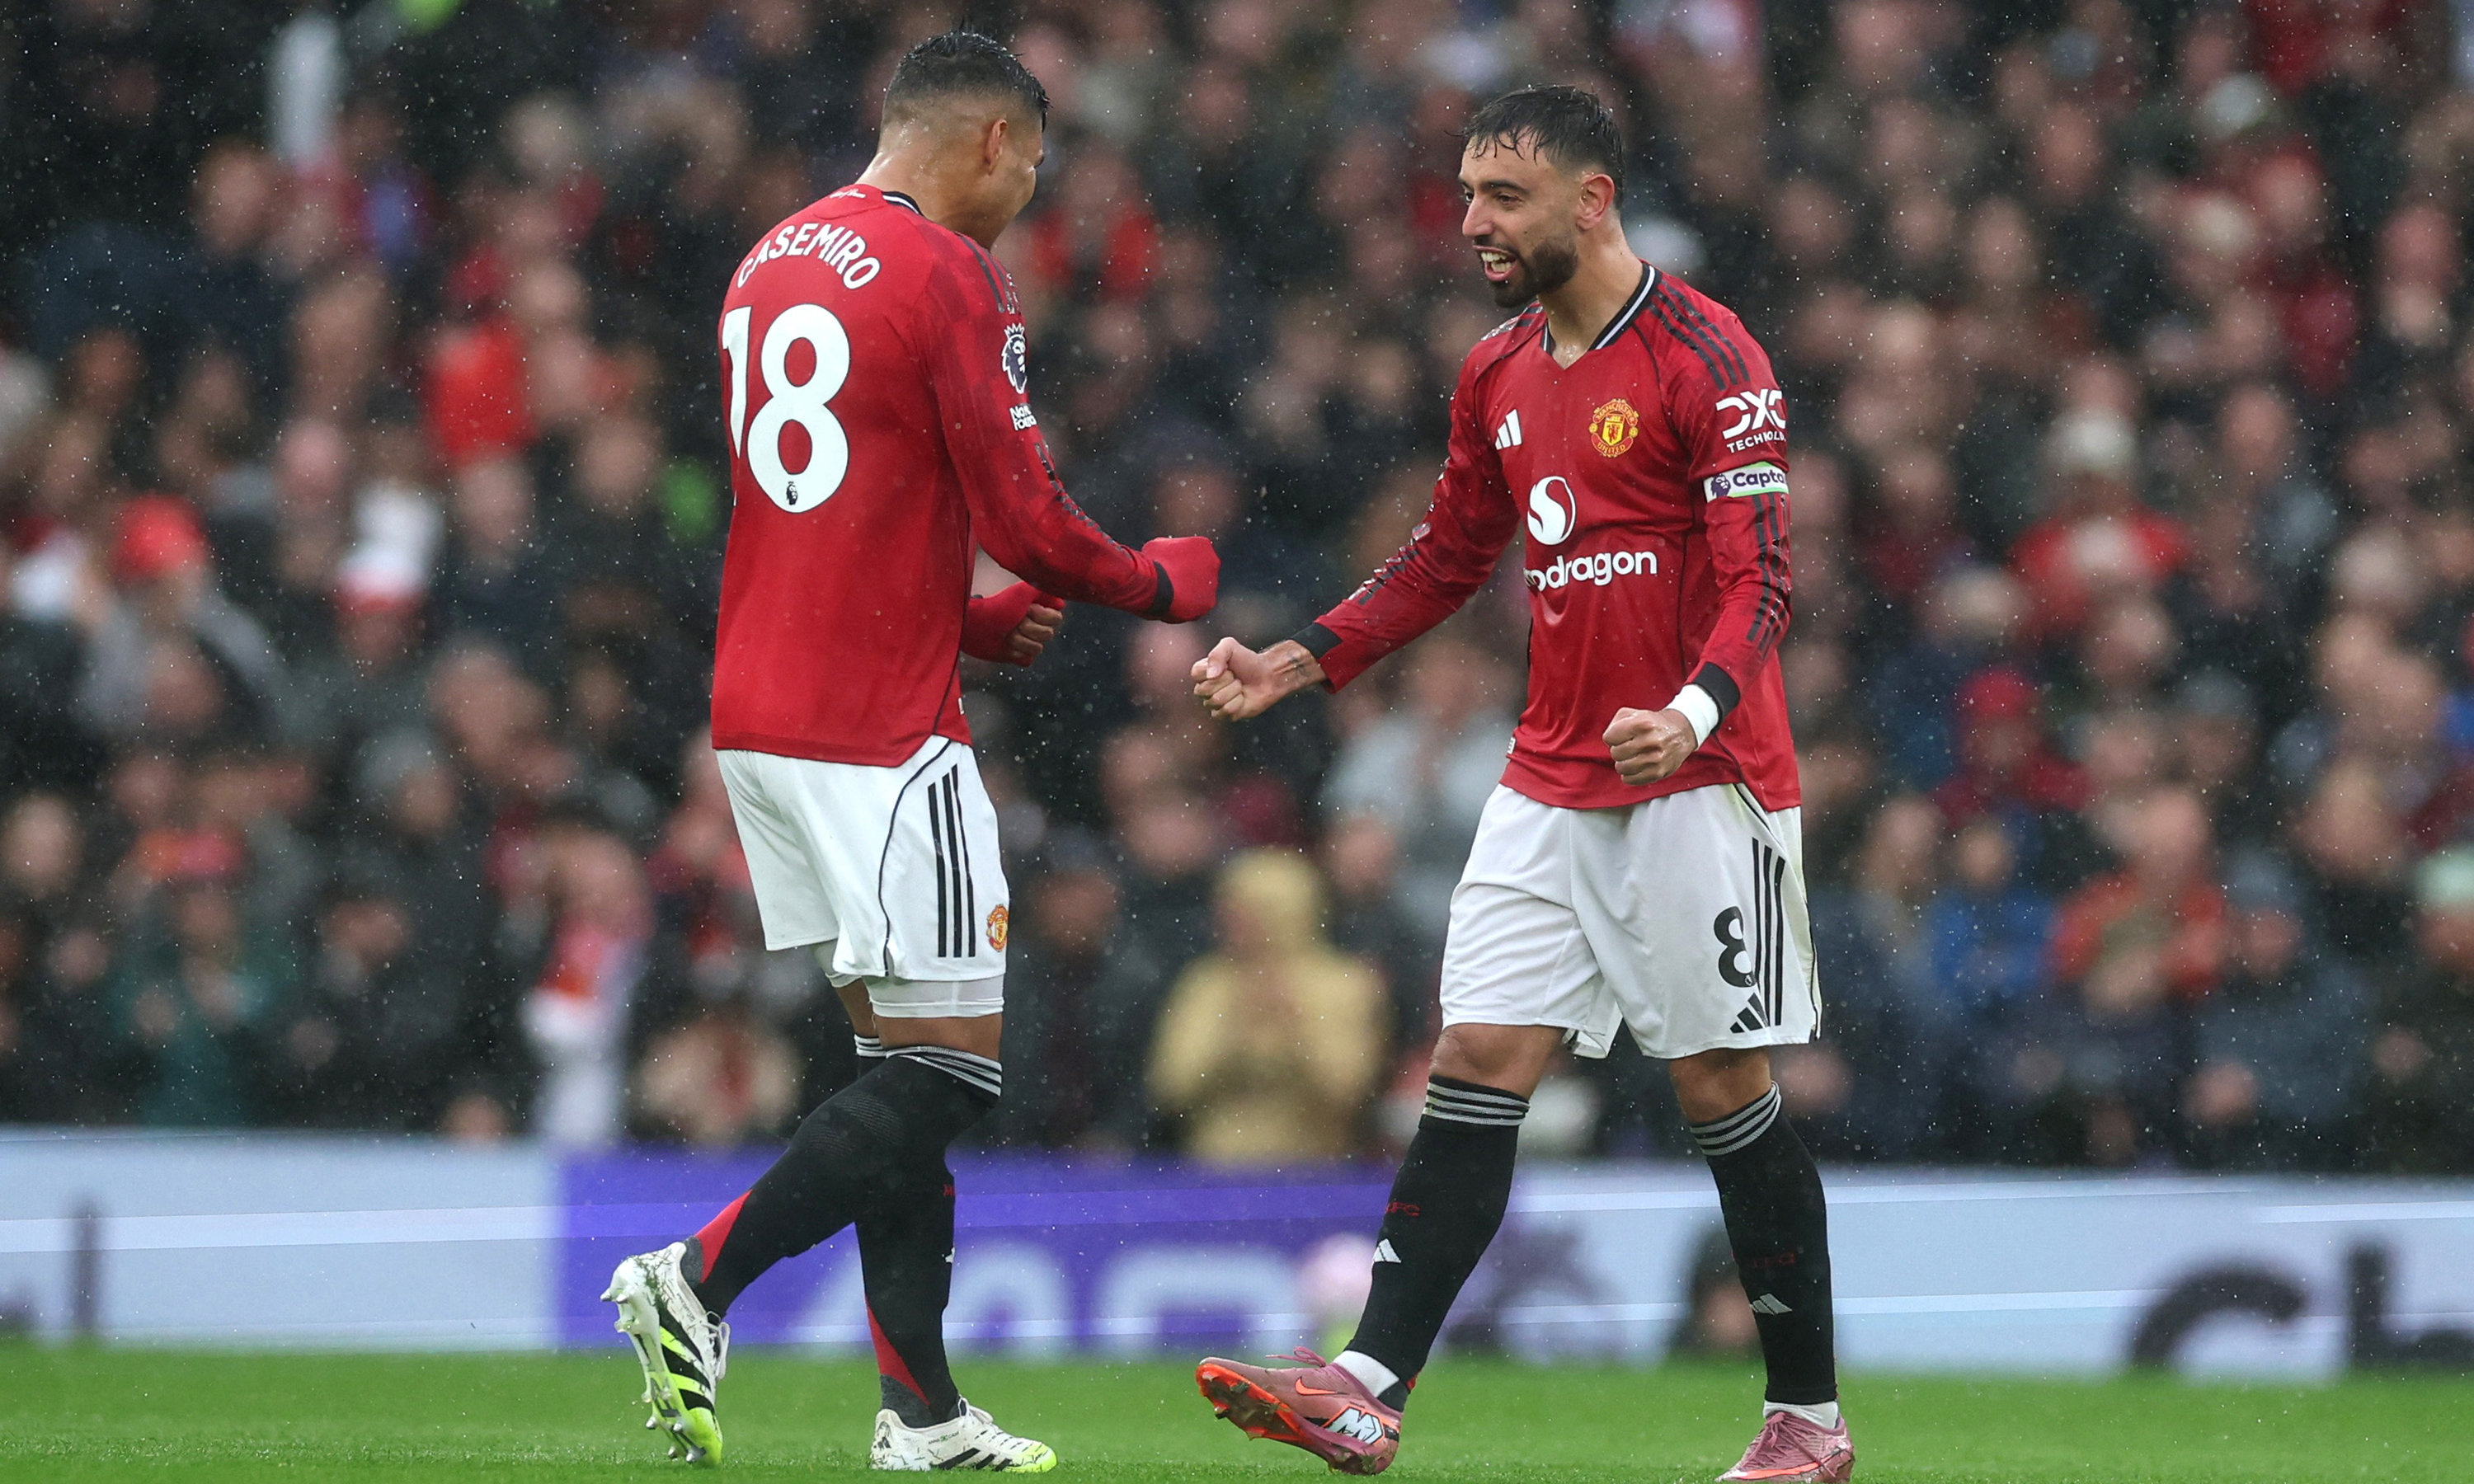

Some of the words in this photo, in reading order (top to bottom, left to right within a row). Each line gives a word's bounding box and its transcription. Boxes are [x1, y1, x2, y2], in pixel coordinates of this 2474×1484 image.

[737, 223, 881, 289] CASEMIRO
[722, 303, 851, 514] 18
[1597, 442, 1625, 454] UNITED
[1714, 905, 1757, 988] 8
